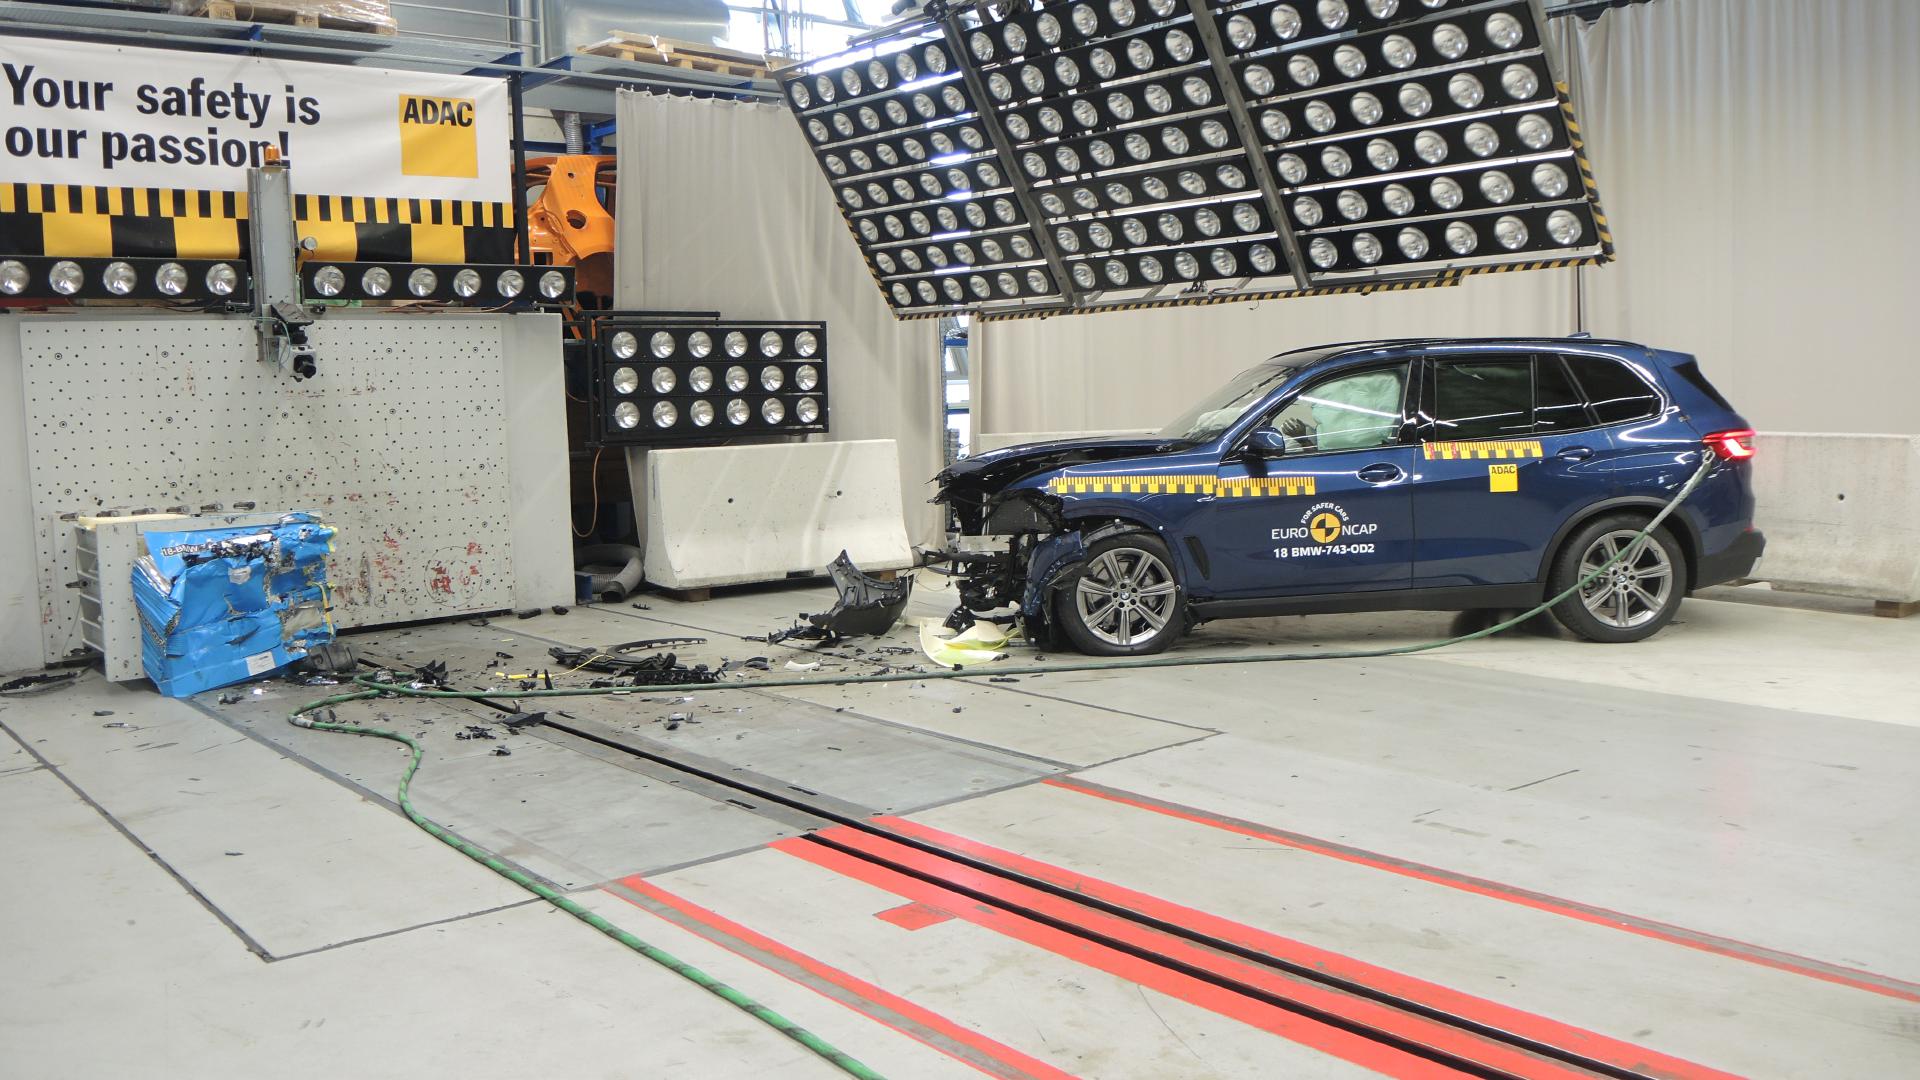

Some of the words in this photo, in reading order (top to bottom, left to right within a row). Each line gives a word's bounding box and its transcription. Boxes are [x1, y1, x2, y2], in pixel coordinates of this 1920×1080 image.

[2, 62, 114, 111] Your
[136, 77, 272, 128] safety
[284, 84, 321, 125] is
[403, 98, 473, 127] ADAC
[5, 125, 88, 159] our
[102, 126, 291, 169] passion!
[1491, 465, 1516, 475] ADAC
[1301, 510, 1313, 524] FOR
[1311, 502, 1335, 512] SAFER
[1334, 505, 1350, 522] CARS
[1271, 527, 1309, 540] EURO
[1342, 523, 1378, 536] NCAP
[1273, 547, 1289, 559] 18
